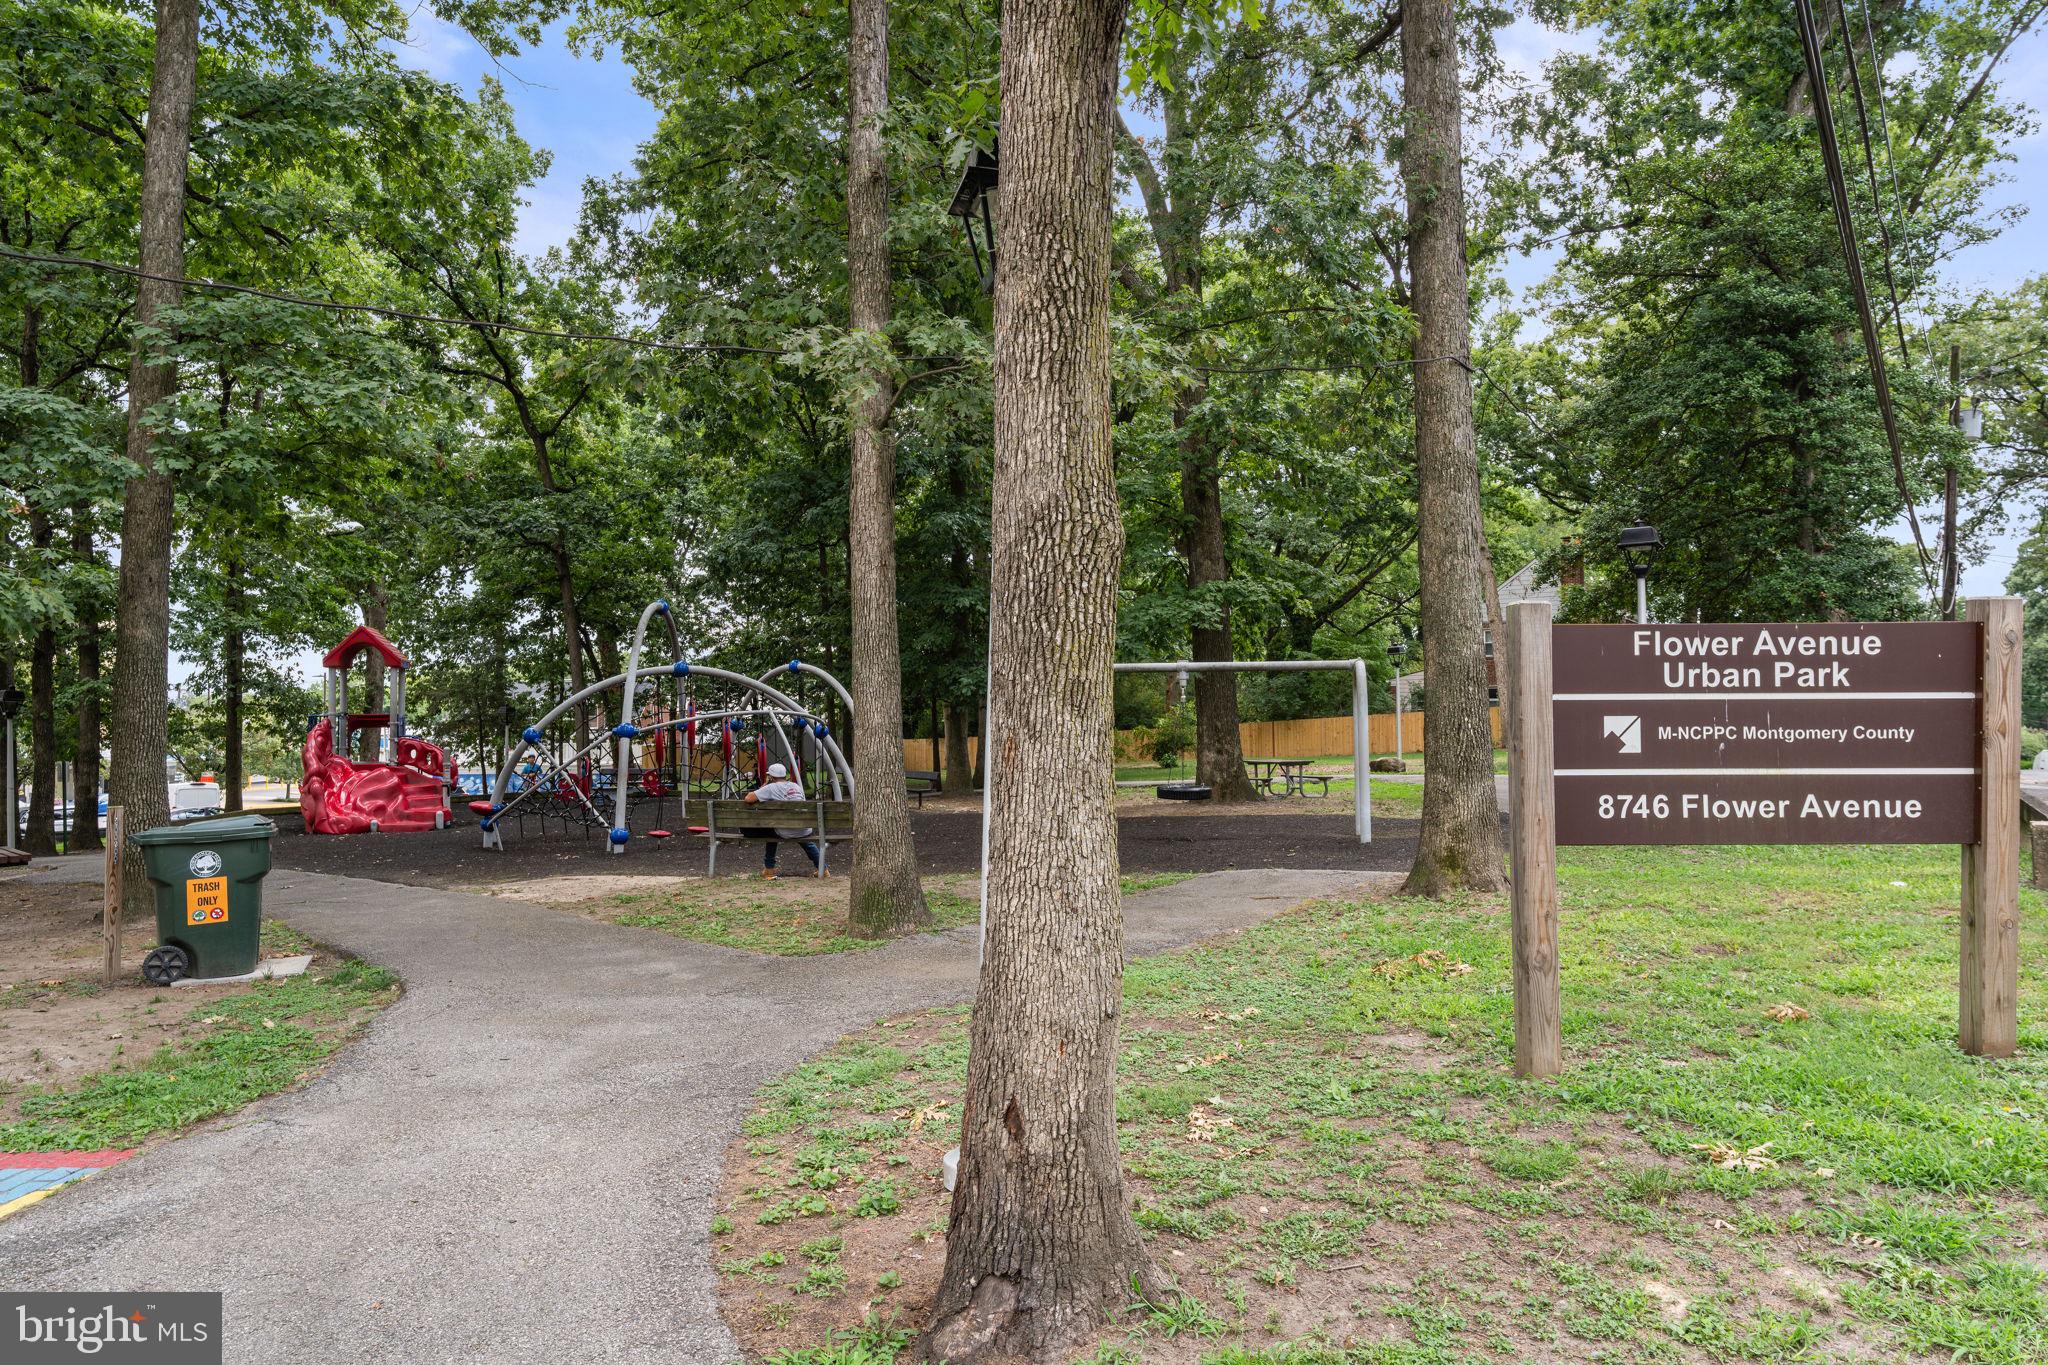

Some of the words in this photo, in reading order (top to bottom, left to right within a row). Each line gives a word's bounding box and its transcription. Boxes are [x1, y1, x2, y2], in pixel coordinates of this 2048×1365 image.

[1633, 629, 1744, 656] Flower
[1752, 628, 1882, 656] Avenue
[1663, 661, 1761, 688] Urban
[1775, 661, 1850, 688] Park
[1658, 726, 1738, 741] M-NCPPC
[1743, 725, 1848, 743] Montgomery
[1853, 725, 1915, 743] County
[1598, 794, 1670, 819] 8746
[1682, 794, 1790, 819] Flower
[1800, 793, 1922, 819] Avenue
[192, 881, 220, 893] TRASH
[197, 895, 219, 907] ONLY
